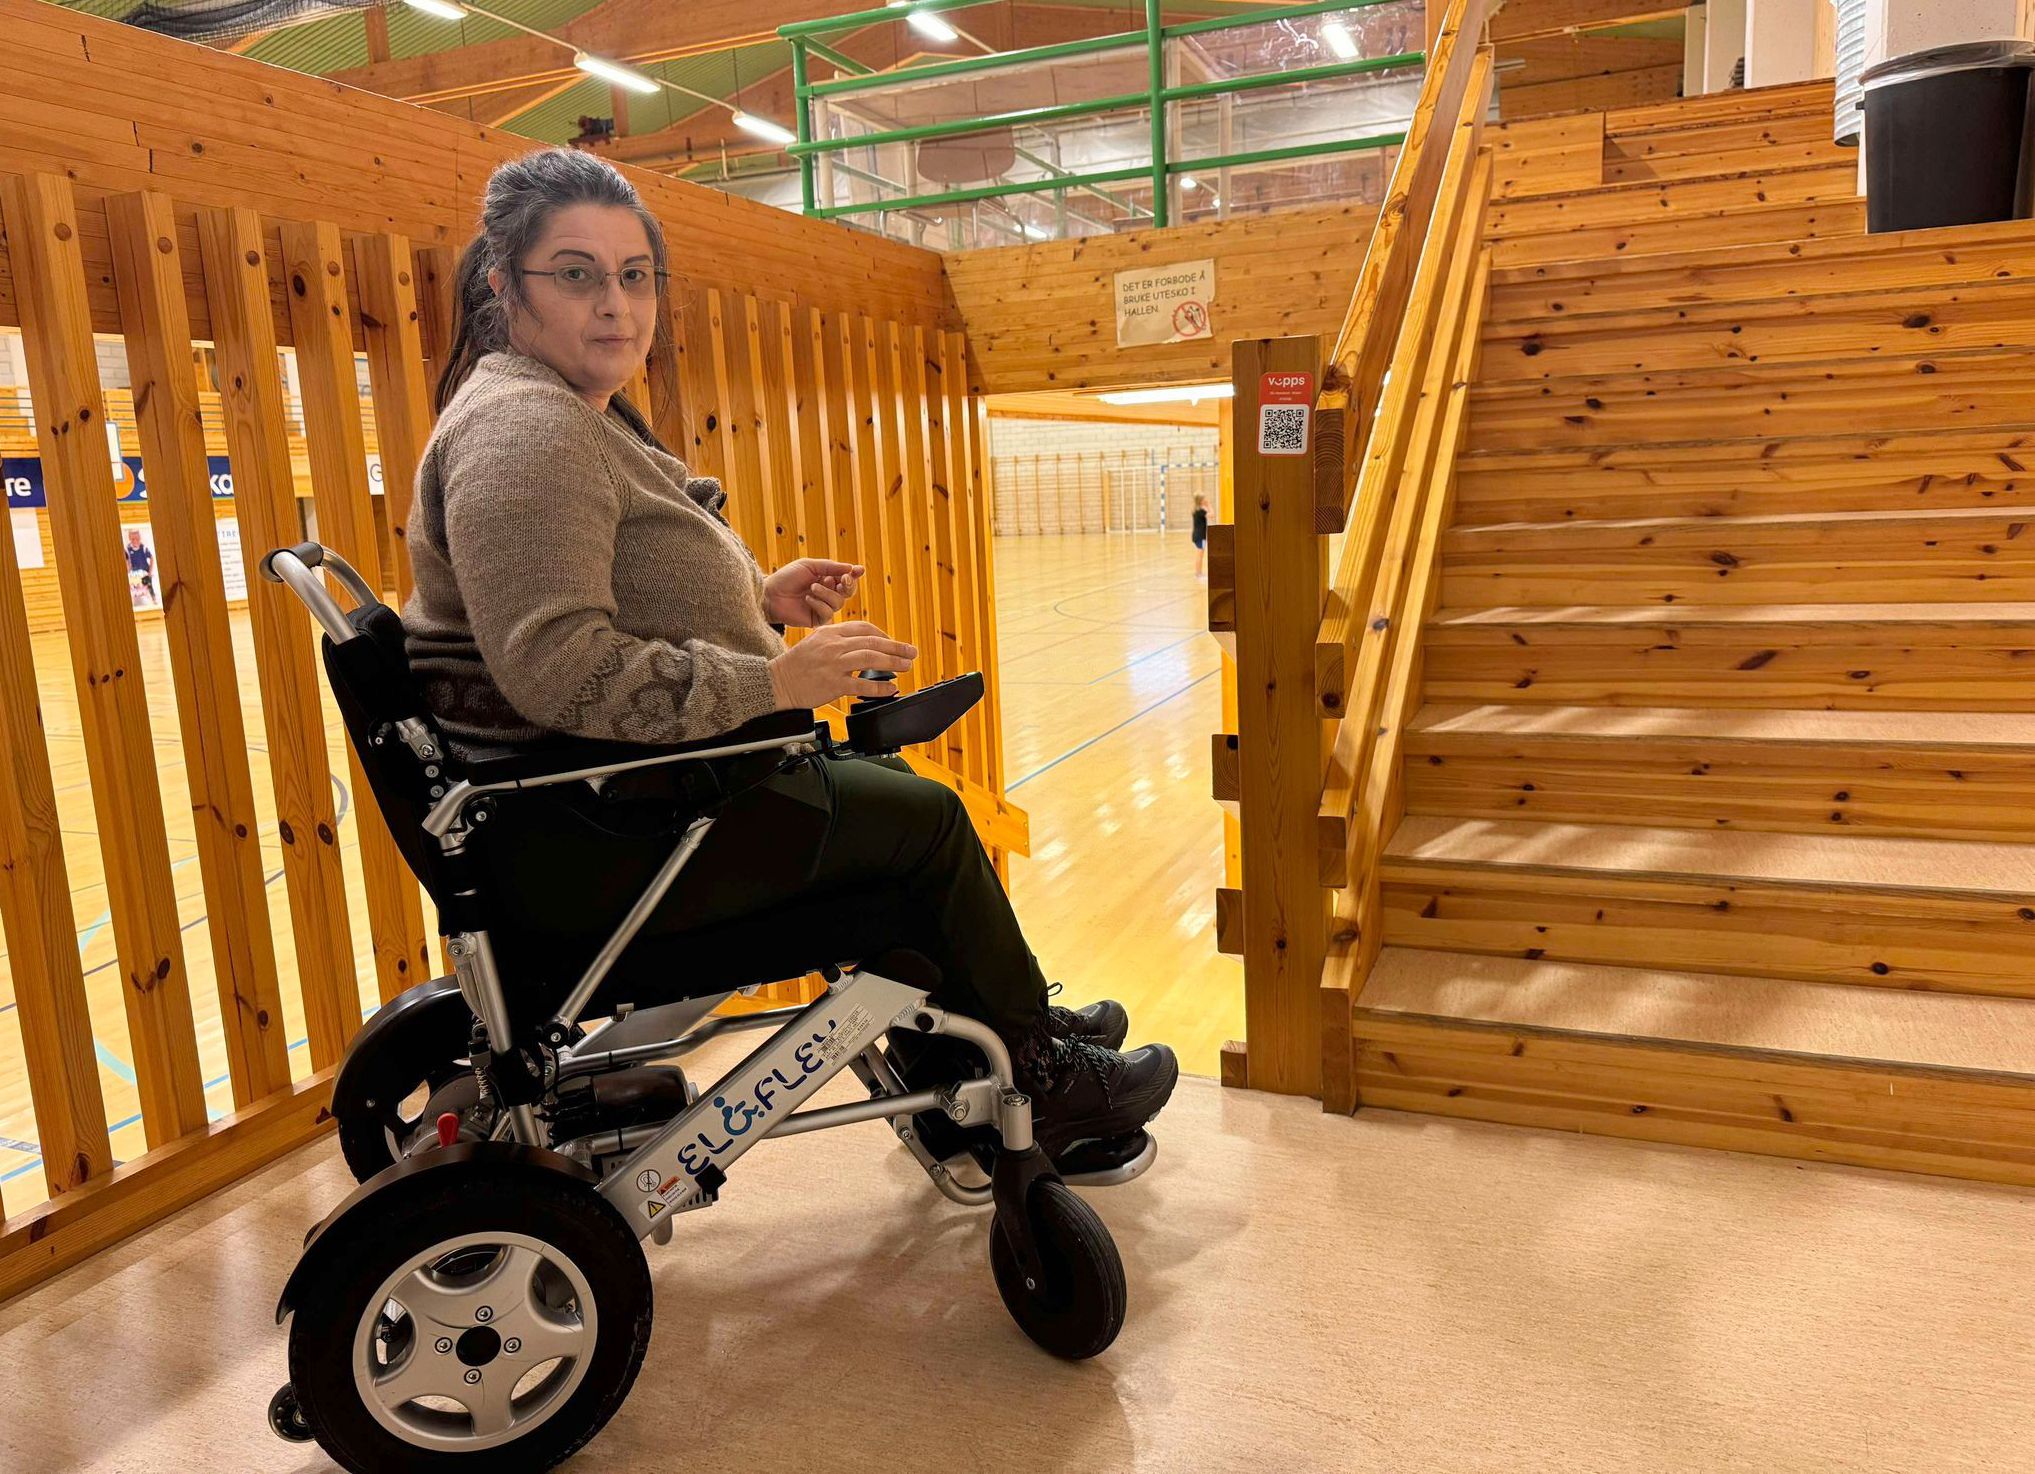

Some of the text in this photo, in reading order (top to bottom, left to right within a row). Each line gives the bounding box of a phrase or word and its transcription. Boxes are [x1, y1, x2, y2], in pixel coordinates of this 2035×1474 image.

[1122, 281, 1140, 292] DET
[1142, 280, 1153, 290] ER
[1155, 272, 1197, 287] FORBODE
[1123, 286, 1197, 304] BRUKE UTESKO I
